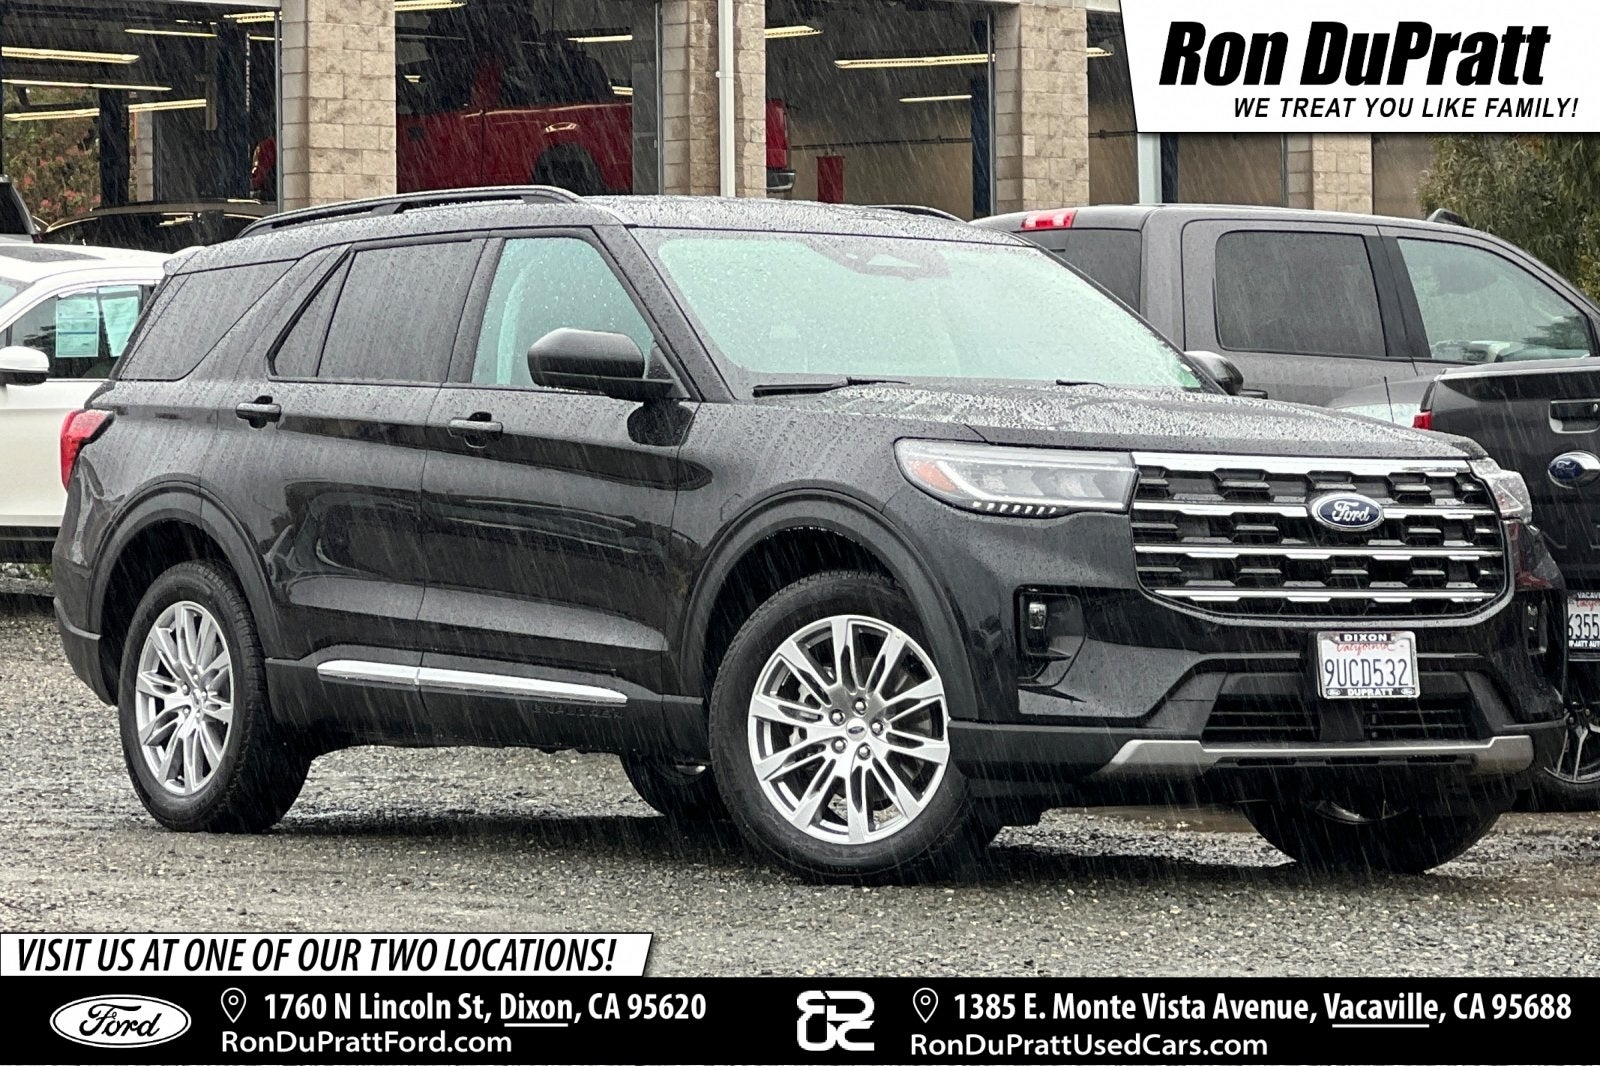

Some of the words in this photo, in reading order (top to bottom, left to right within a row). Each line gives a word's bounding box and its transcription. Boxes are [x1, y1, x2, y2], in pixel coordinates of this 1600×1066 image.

[1332, 500, 1370, 521] Ford
[1343, 633, 1388, 642] DIXON
[1325, 658, 1408, 687] 9UCD532
[1347, 688, 1394, 696] DUPRATT
